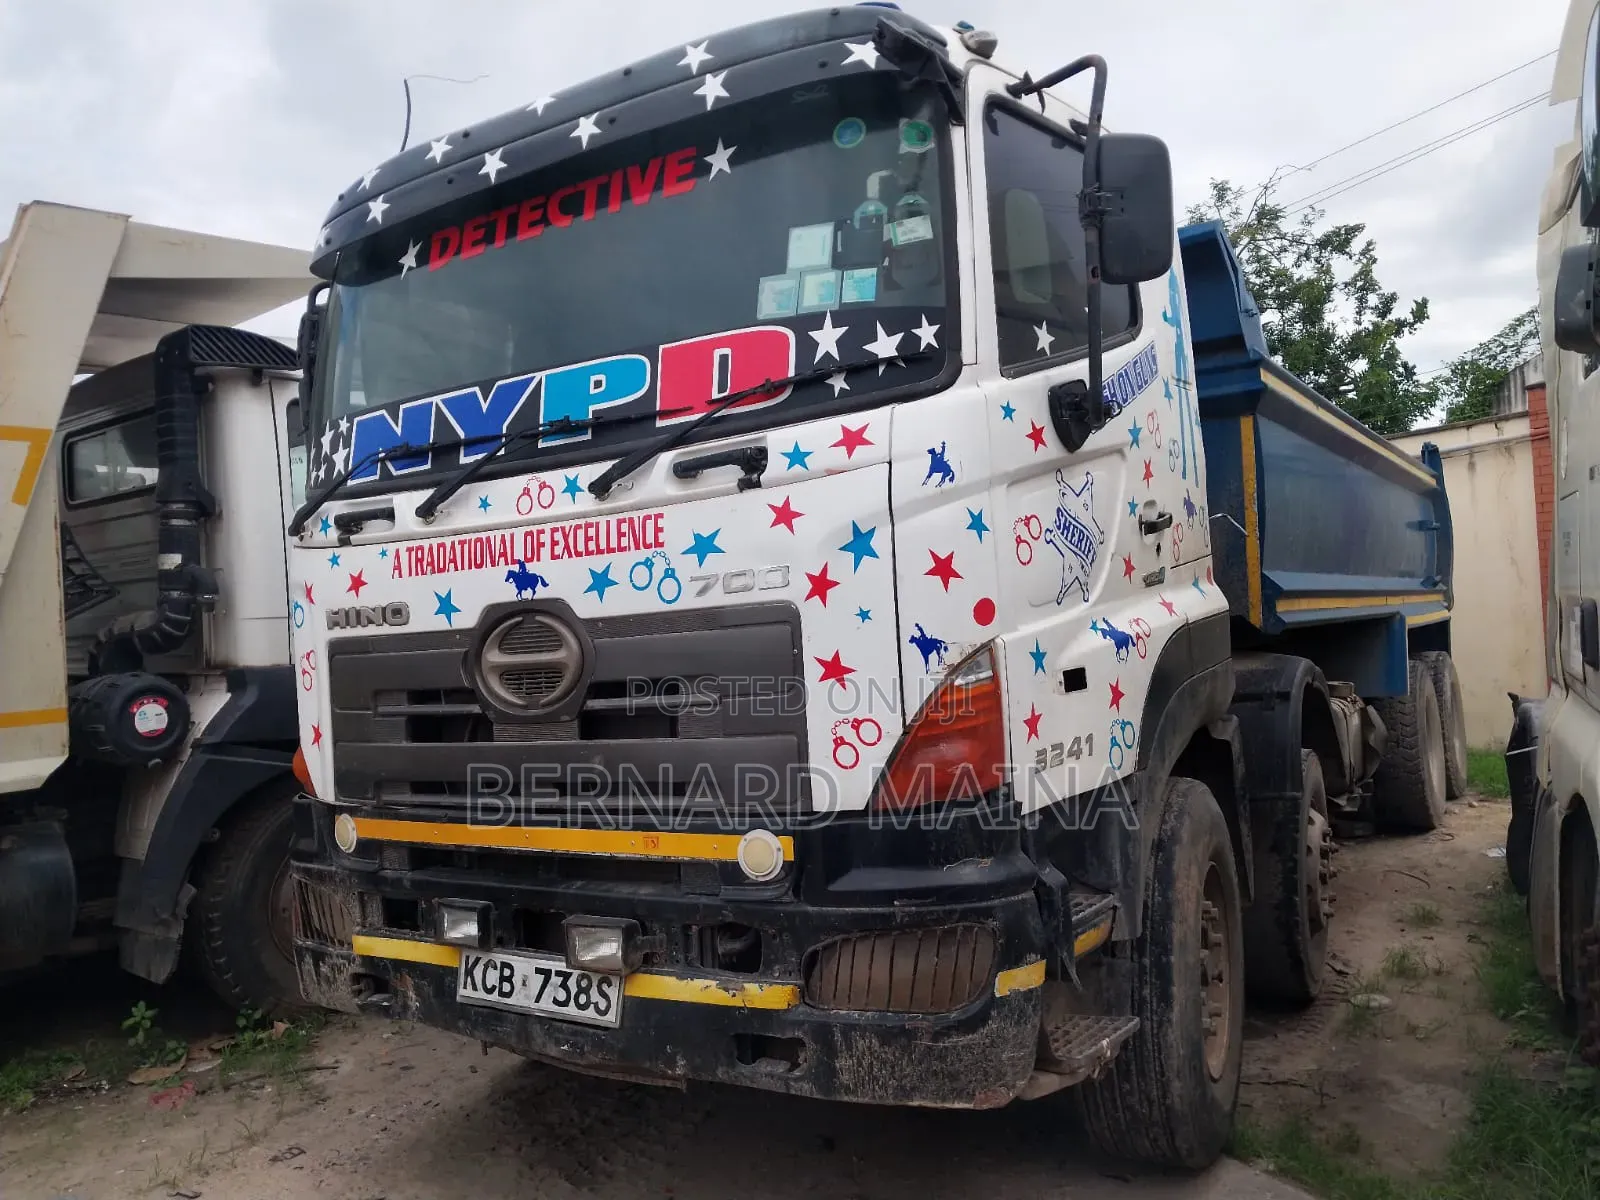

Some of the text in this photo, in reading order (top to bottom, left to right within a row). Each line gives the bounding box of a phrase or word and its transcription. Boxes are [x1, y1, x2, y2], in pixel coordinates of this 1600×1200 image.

[428, 147, 697, 272] DETECTIVE
[347, 325, 796, 486] NYPD
[392, 513, 665, 579] A TRADATIONAL OF EXCELLENCE
[688, 564, 790, 598] 700
[325, 602, 410, 630] HINO
[462, 954, 613, 1017] KCB 738S
